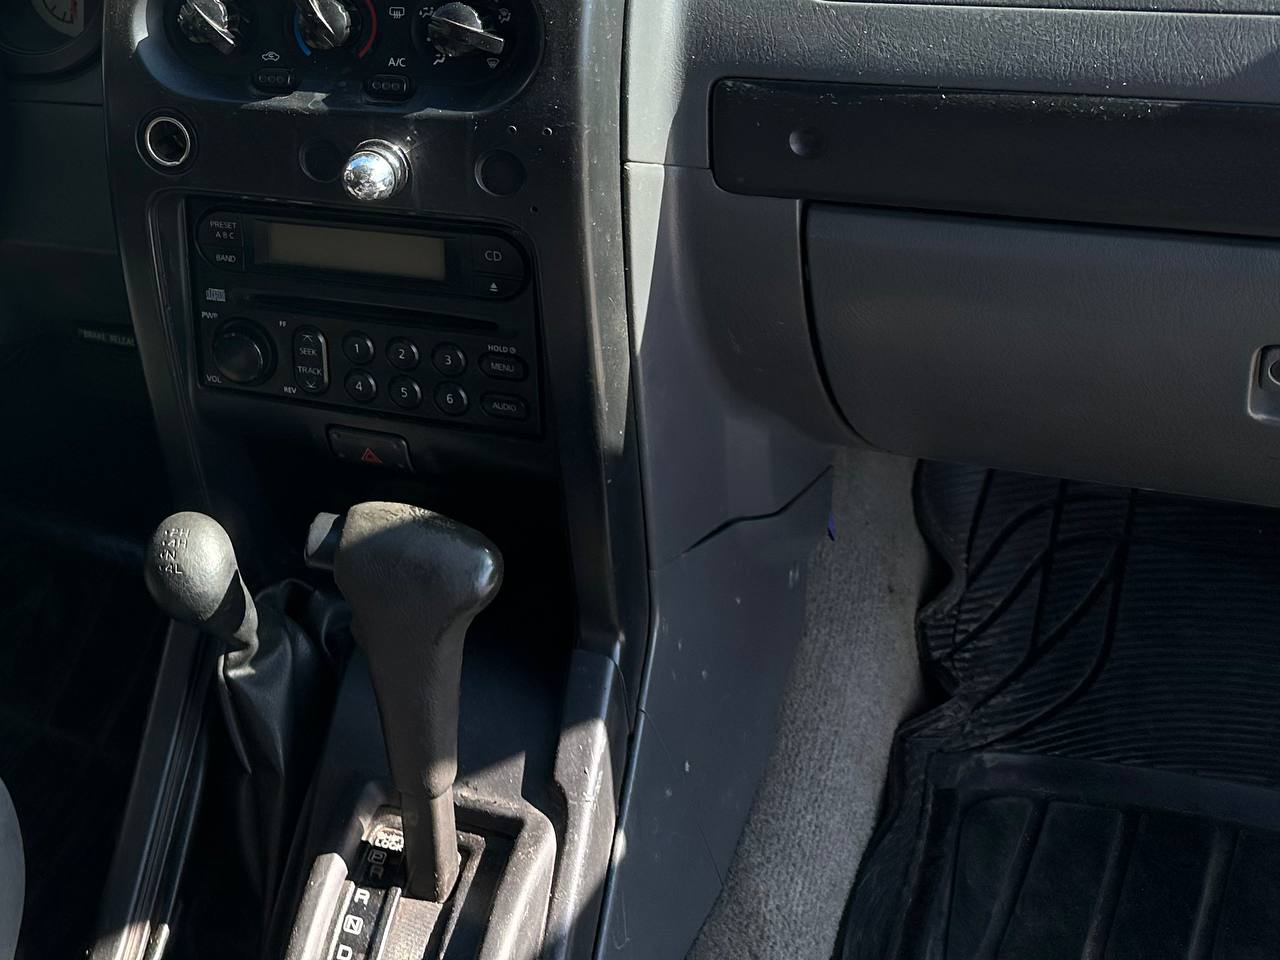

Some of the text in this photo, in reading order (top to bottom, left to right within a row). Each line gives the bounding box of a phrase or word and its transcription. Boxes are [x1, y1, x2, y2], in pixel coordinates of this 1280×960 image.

[387, 57, 407, 69] A/C
[209, 220, 238, 230] PRESET
[215, 254, 237, 263] BAND
[484, 249, 503, 262] CD
[299, 347, 318, 356] SEEK
[397, 348, 406, 360] 2
[487, 344, 509, 353] HOLD
[444, 354, 453, 366] 3
[296, 365, 323, 376] TRACK
[490, 362, 515, 373] MENU
[206, 375, 223, 384] VOL
[354, 380, 363, 392] 4
[400, 386, 408, 398] 5
[446, 393, 455, 405] 6
[492, 401, 518, 412] AUDIO
[169, 527, 191, 538] 2H
[167, 538, 188, 549] 4H
[164, 563, 183, 574] 4L
[353, 887, 371, 906] R
[336, 944, 353, 960] D
